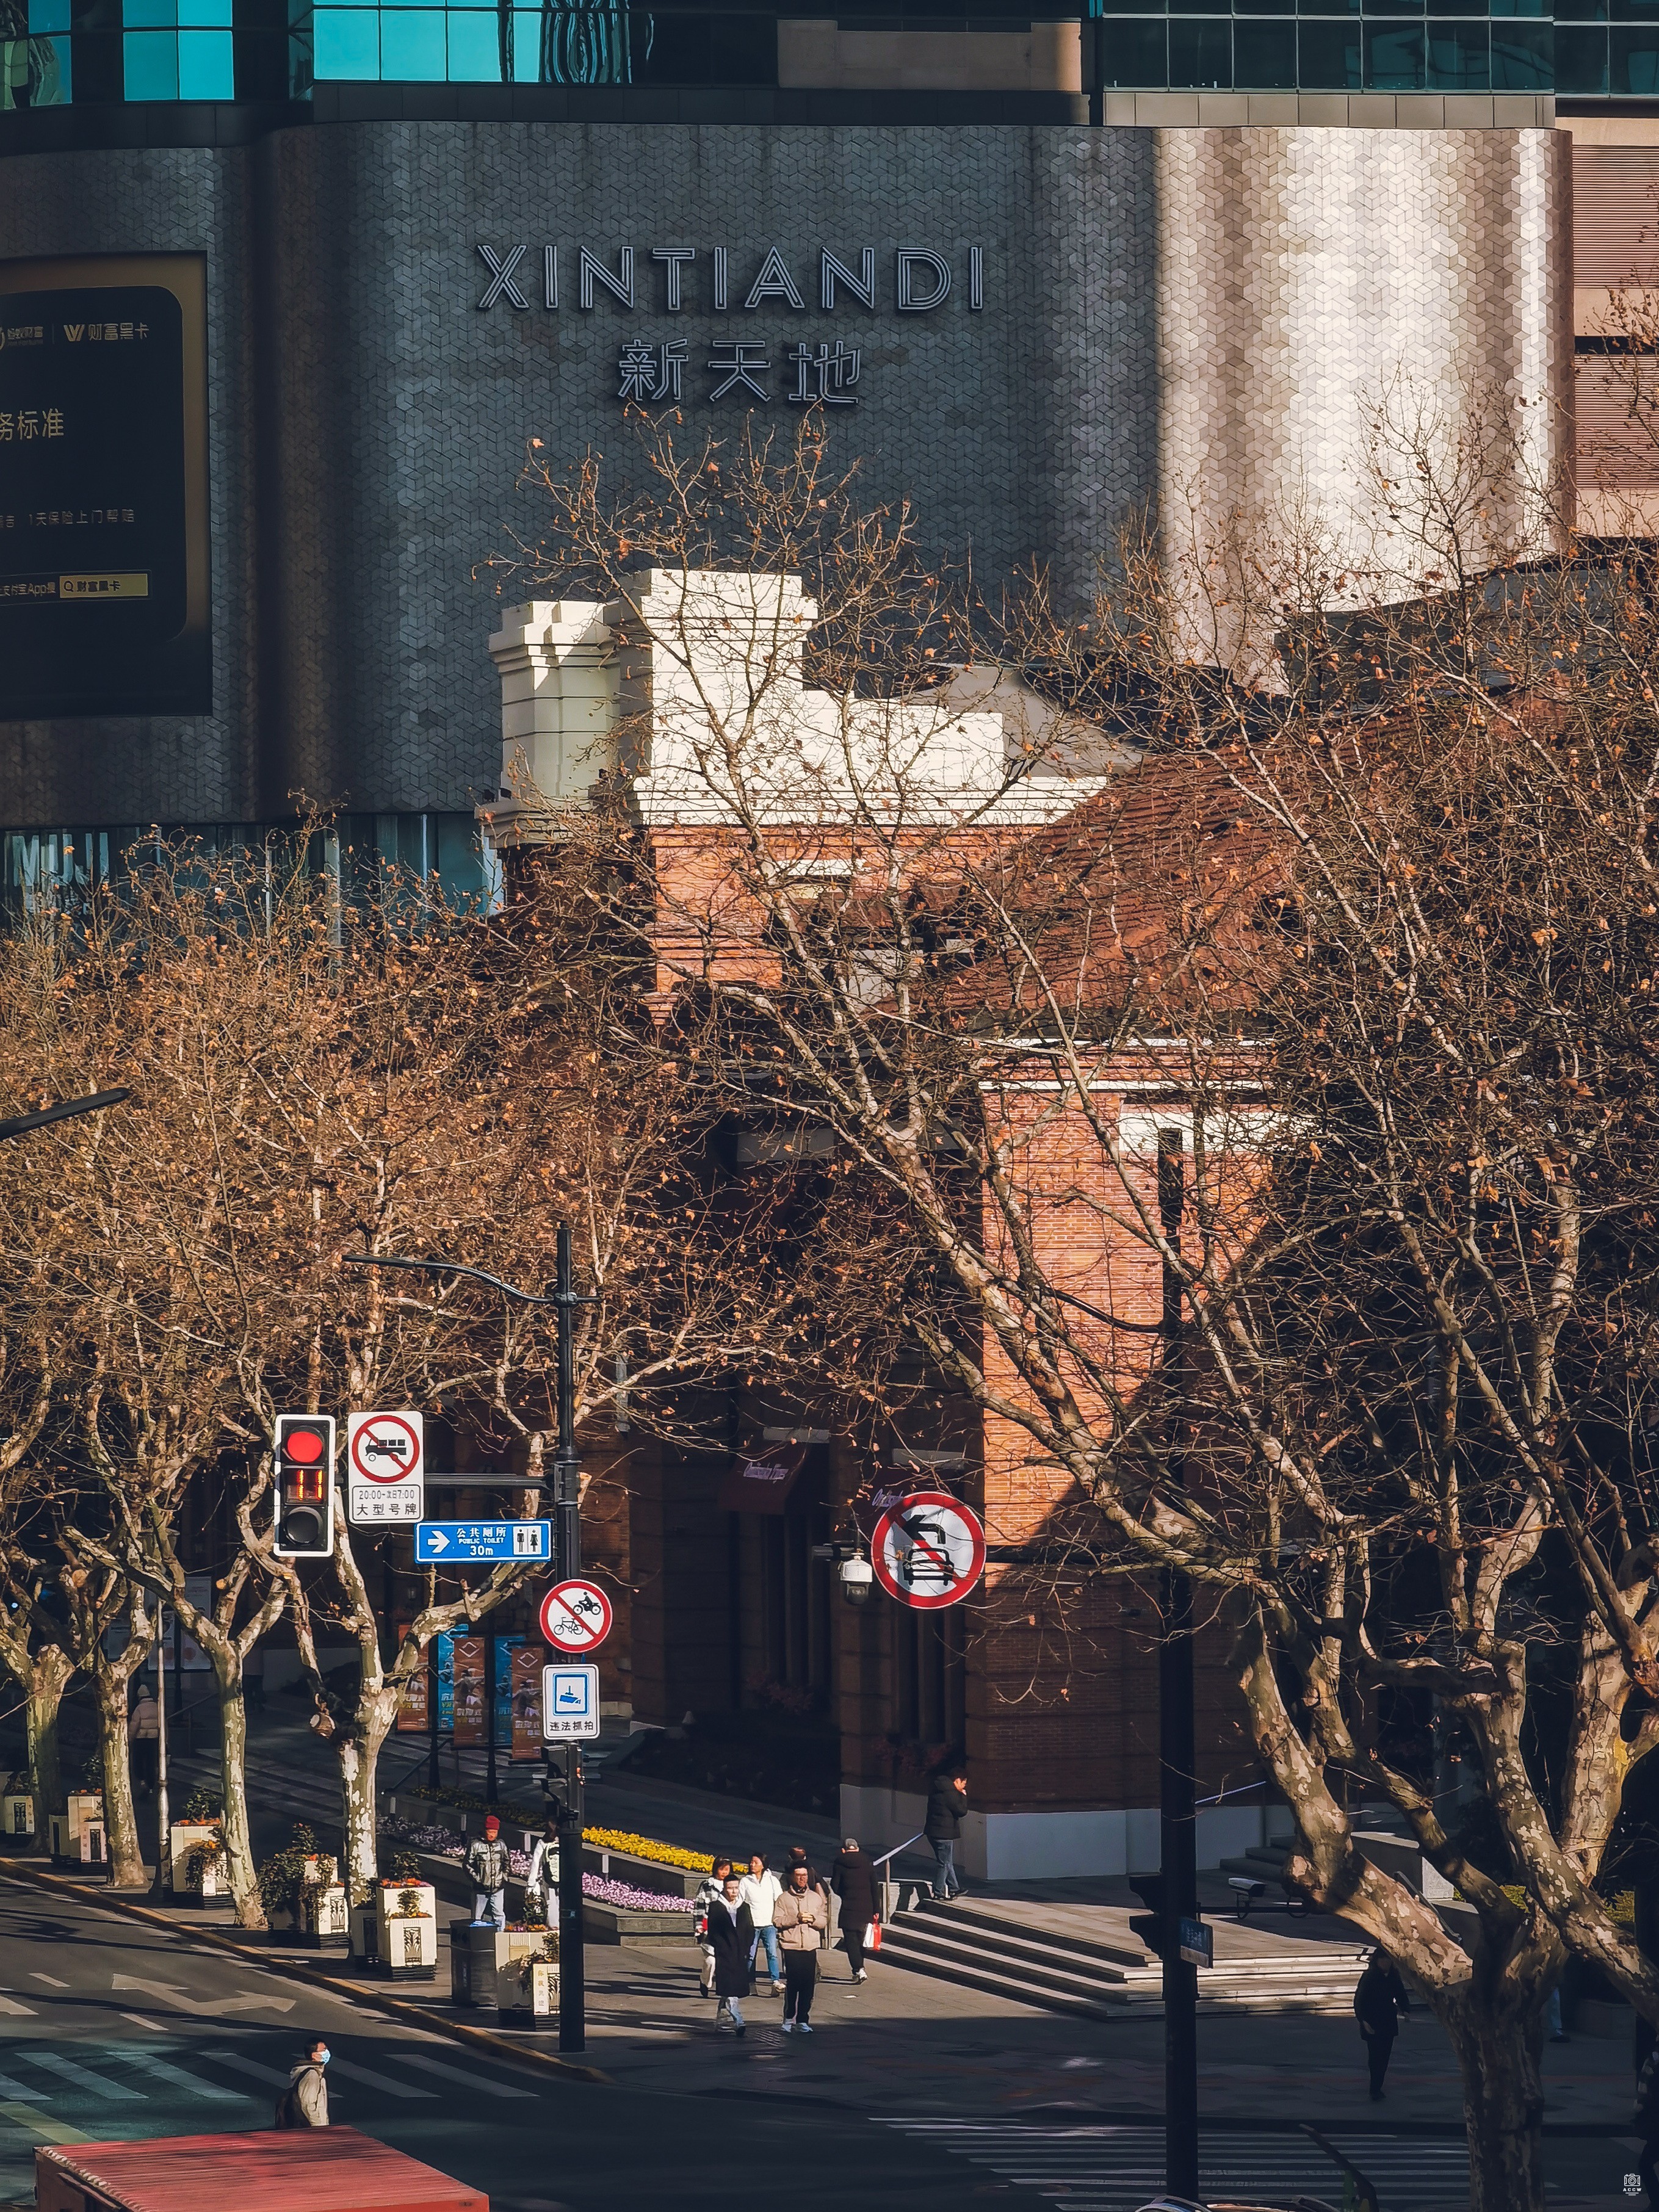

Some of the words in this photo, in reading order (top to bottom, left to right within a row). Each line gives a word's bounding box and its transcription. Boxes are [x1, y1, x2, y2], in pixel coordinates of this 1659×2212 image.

[477, 245, 983, 311] XINTIANDI
[618, 339, 860, 403] 新天地
[356, 1503, 417, 1515] 大型号牌
[469, 1545, 494, 1556] 30m
[550, 1721, 593, 1731] 违法抓拍
